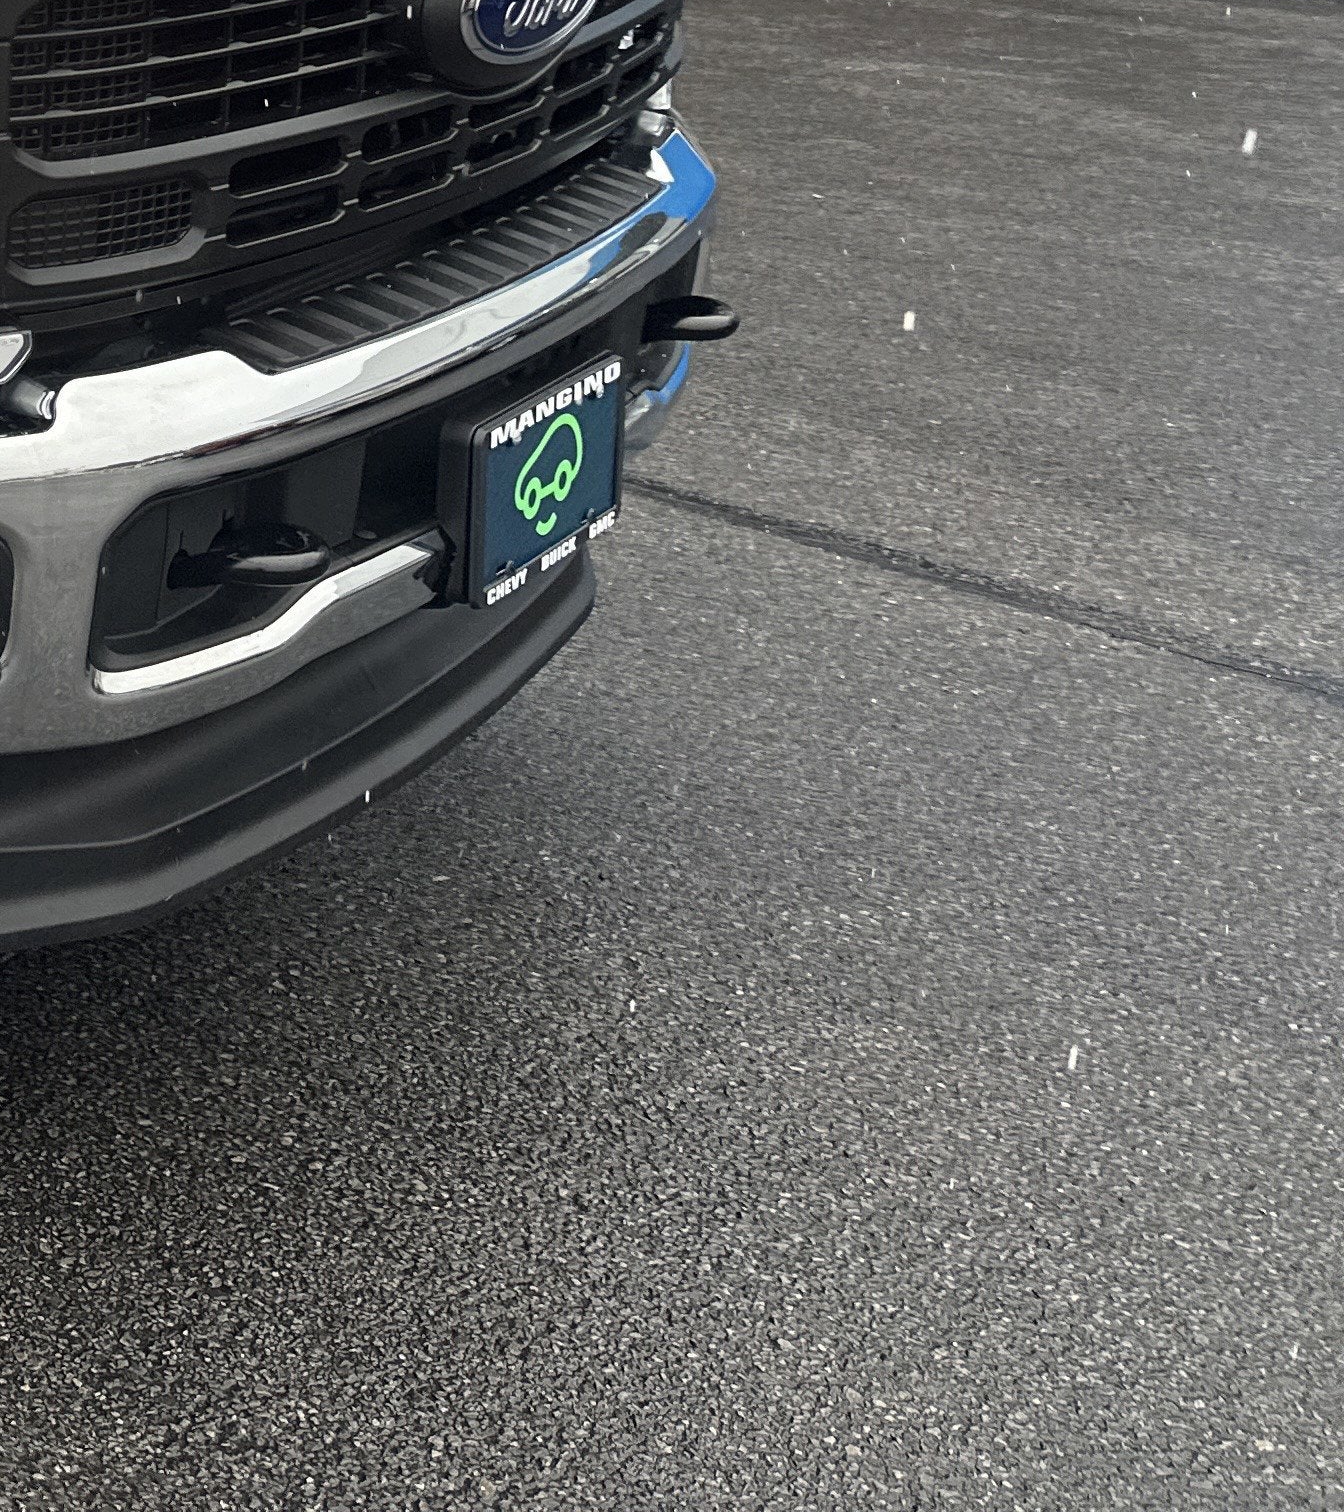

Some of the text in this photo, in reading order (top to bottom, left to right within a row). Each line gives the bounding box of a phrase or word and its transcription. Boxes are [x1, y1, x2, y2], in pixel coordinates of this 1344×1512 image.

[489, 361, 622, 450] MANGINO
[486, 511, 616, 606] CHEVY BUICK GMC
